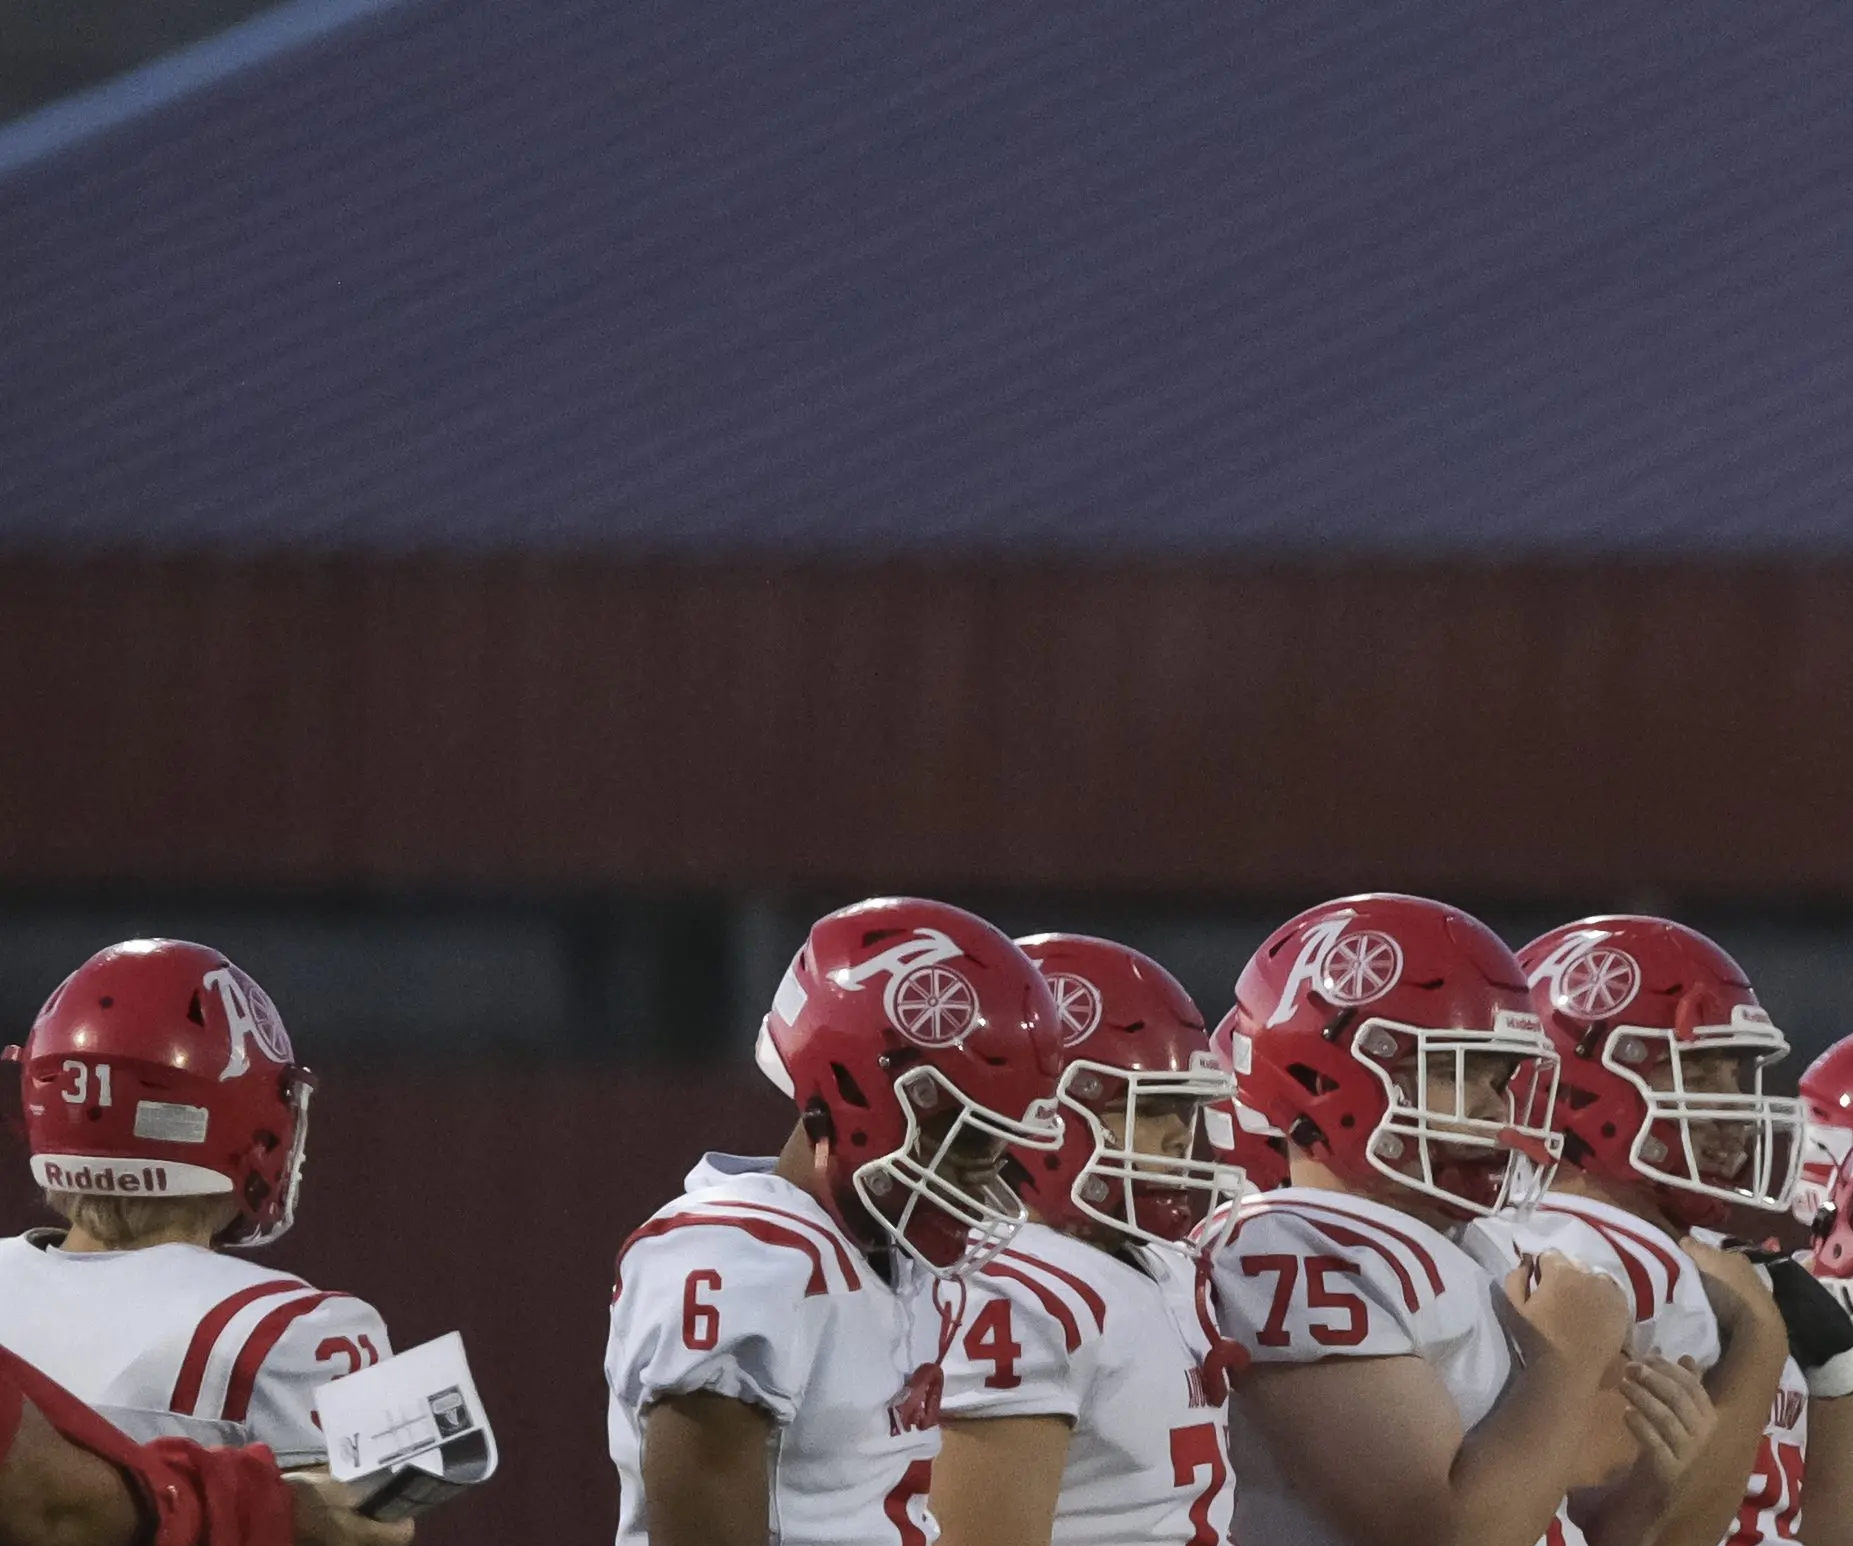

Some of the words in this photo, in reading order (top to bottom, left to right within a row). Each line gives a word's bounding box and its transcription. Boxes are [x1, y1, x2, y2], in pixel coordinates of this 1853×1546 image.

[61, 1060, 112, 1107] 31
[44, 1162, 167, 1192] Riddell
[682, 1269, 722, 1351] 6
[1240, 1254, 1369, 1347] 75
[963, 1299, 1022, 1389] 4
